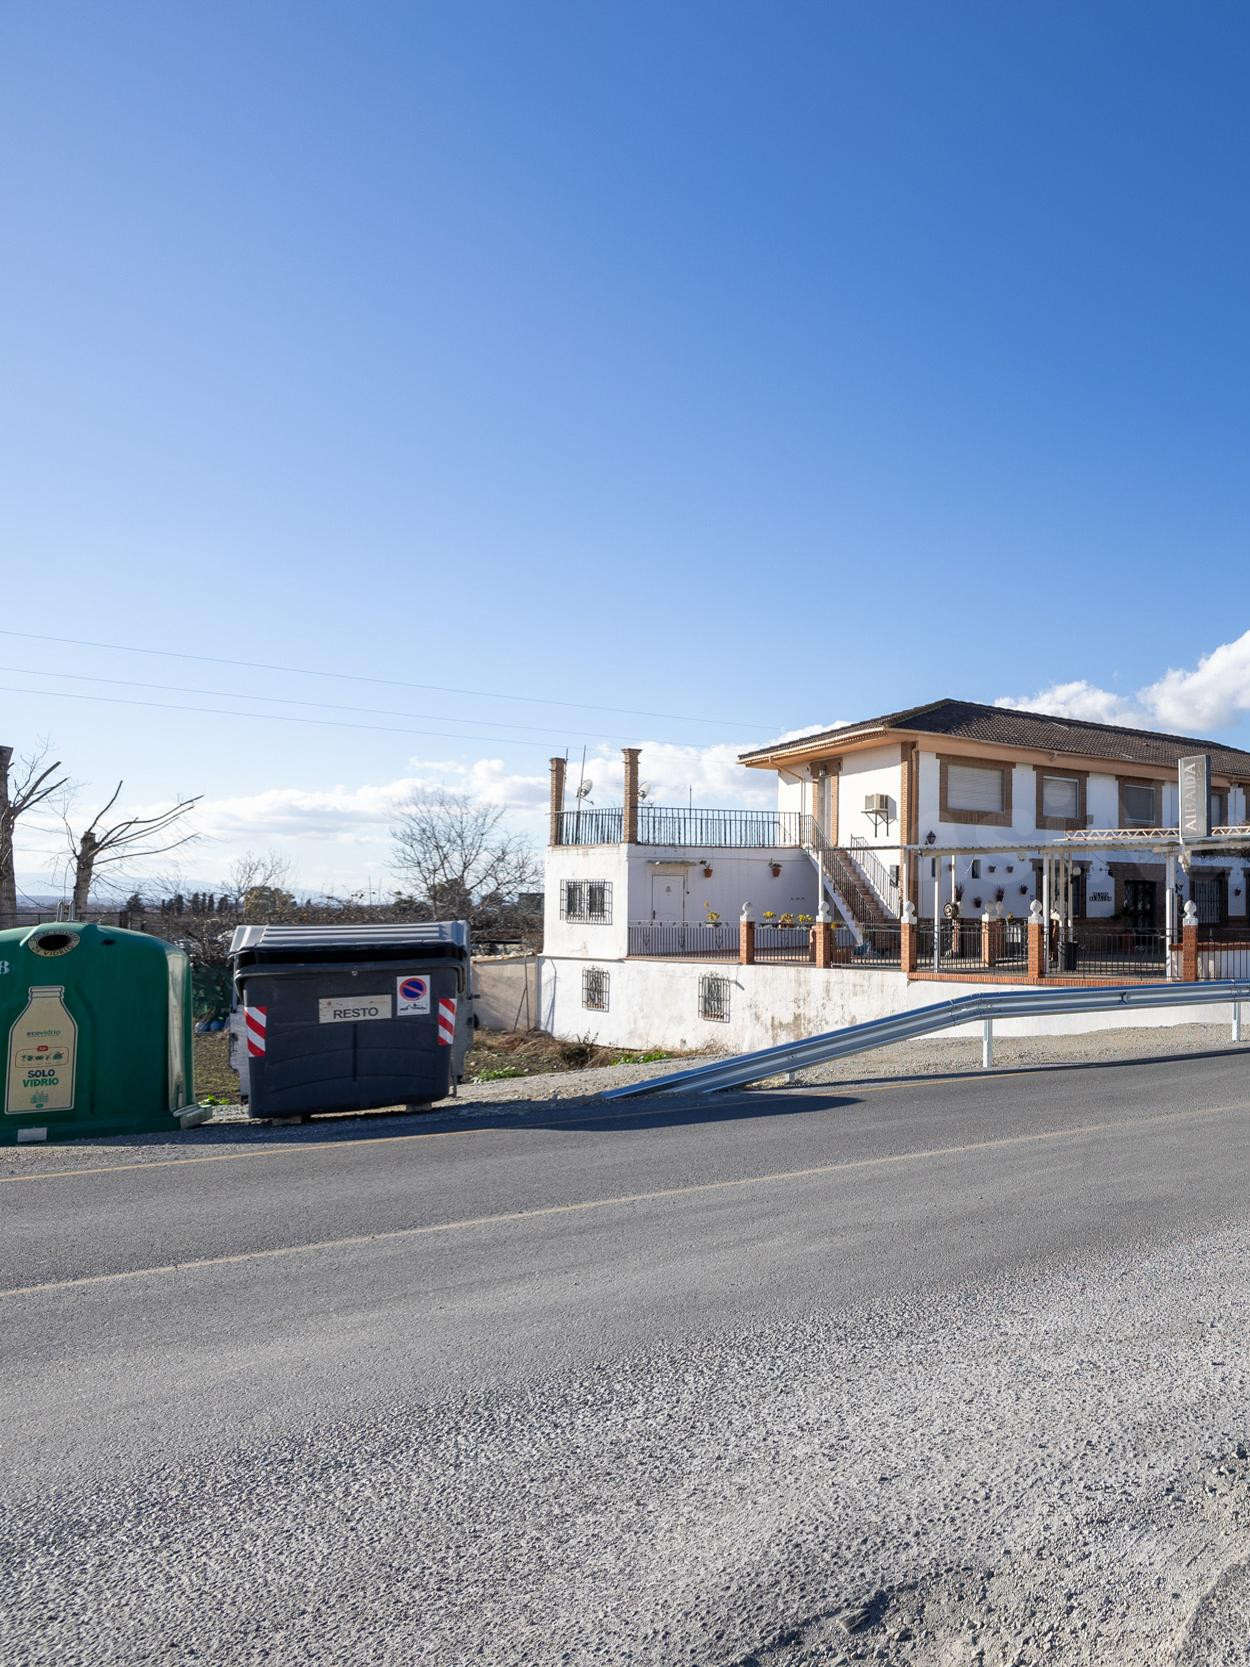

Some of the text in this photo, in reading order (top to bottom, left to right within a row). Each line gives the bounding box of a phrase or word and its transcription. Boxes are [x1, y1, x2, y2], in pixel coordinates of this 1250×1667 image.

[333, 1007, 379, 1019] RESTO
[28, 1069, 56, 1078] SOLO
[22, 1077, 59, 1088] VIDRIO
